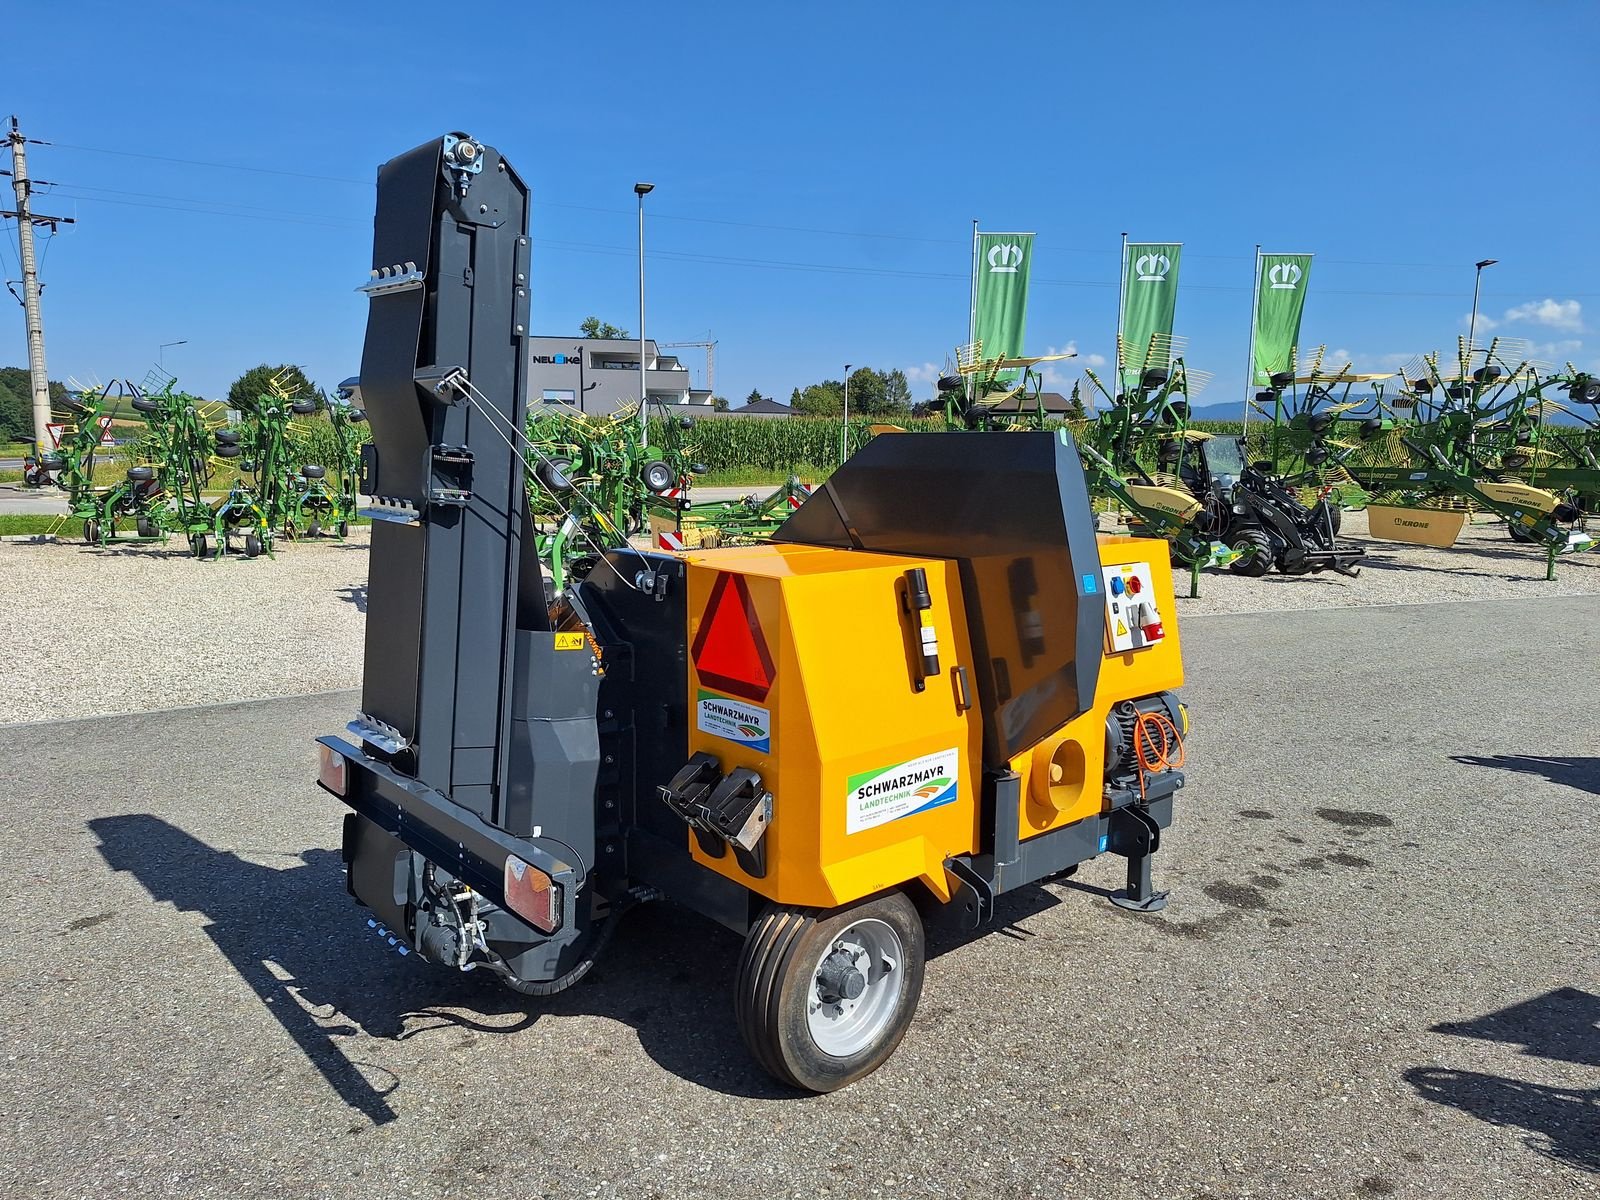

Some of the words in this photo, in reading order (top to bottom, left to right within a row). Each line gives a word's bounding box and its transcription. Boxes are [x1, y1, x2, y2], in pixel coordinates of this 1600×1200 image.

[1517, 499, 1542, 508] KRONE
[1401, 520, 1429, 529] KRONE
[703, 700, 760, 726] SCHWARZMAYR
[704, 712, 737, 728] LANDTECHNIK
[857, 765, 945, 800] SCHWARZMAYR
[859, 790, 912, 811] LANDTECHNIK
